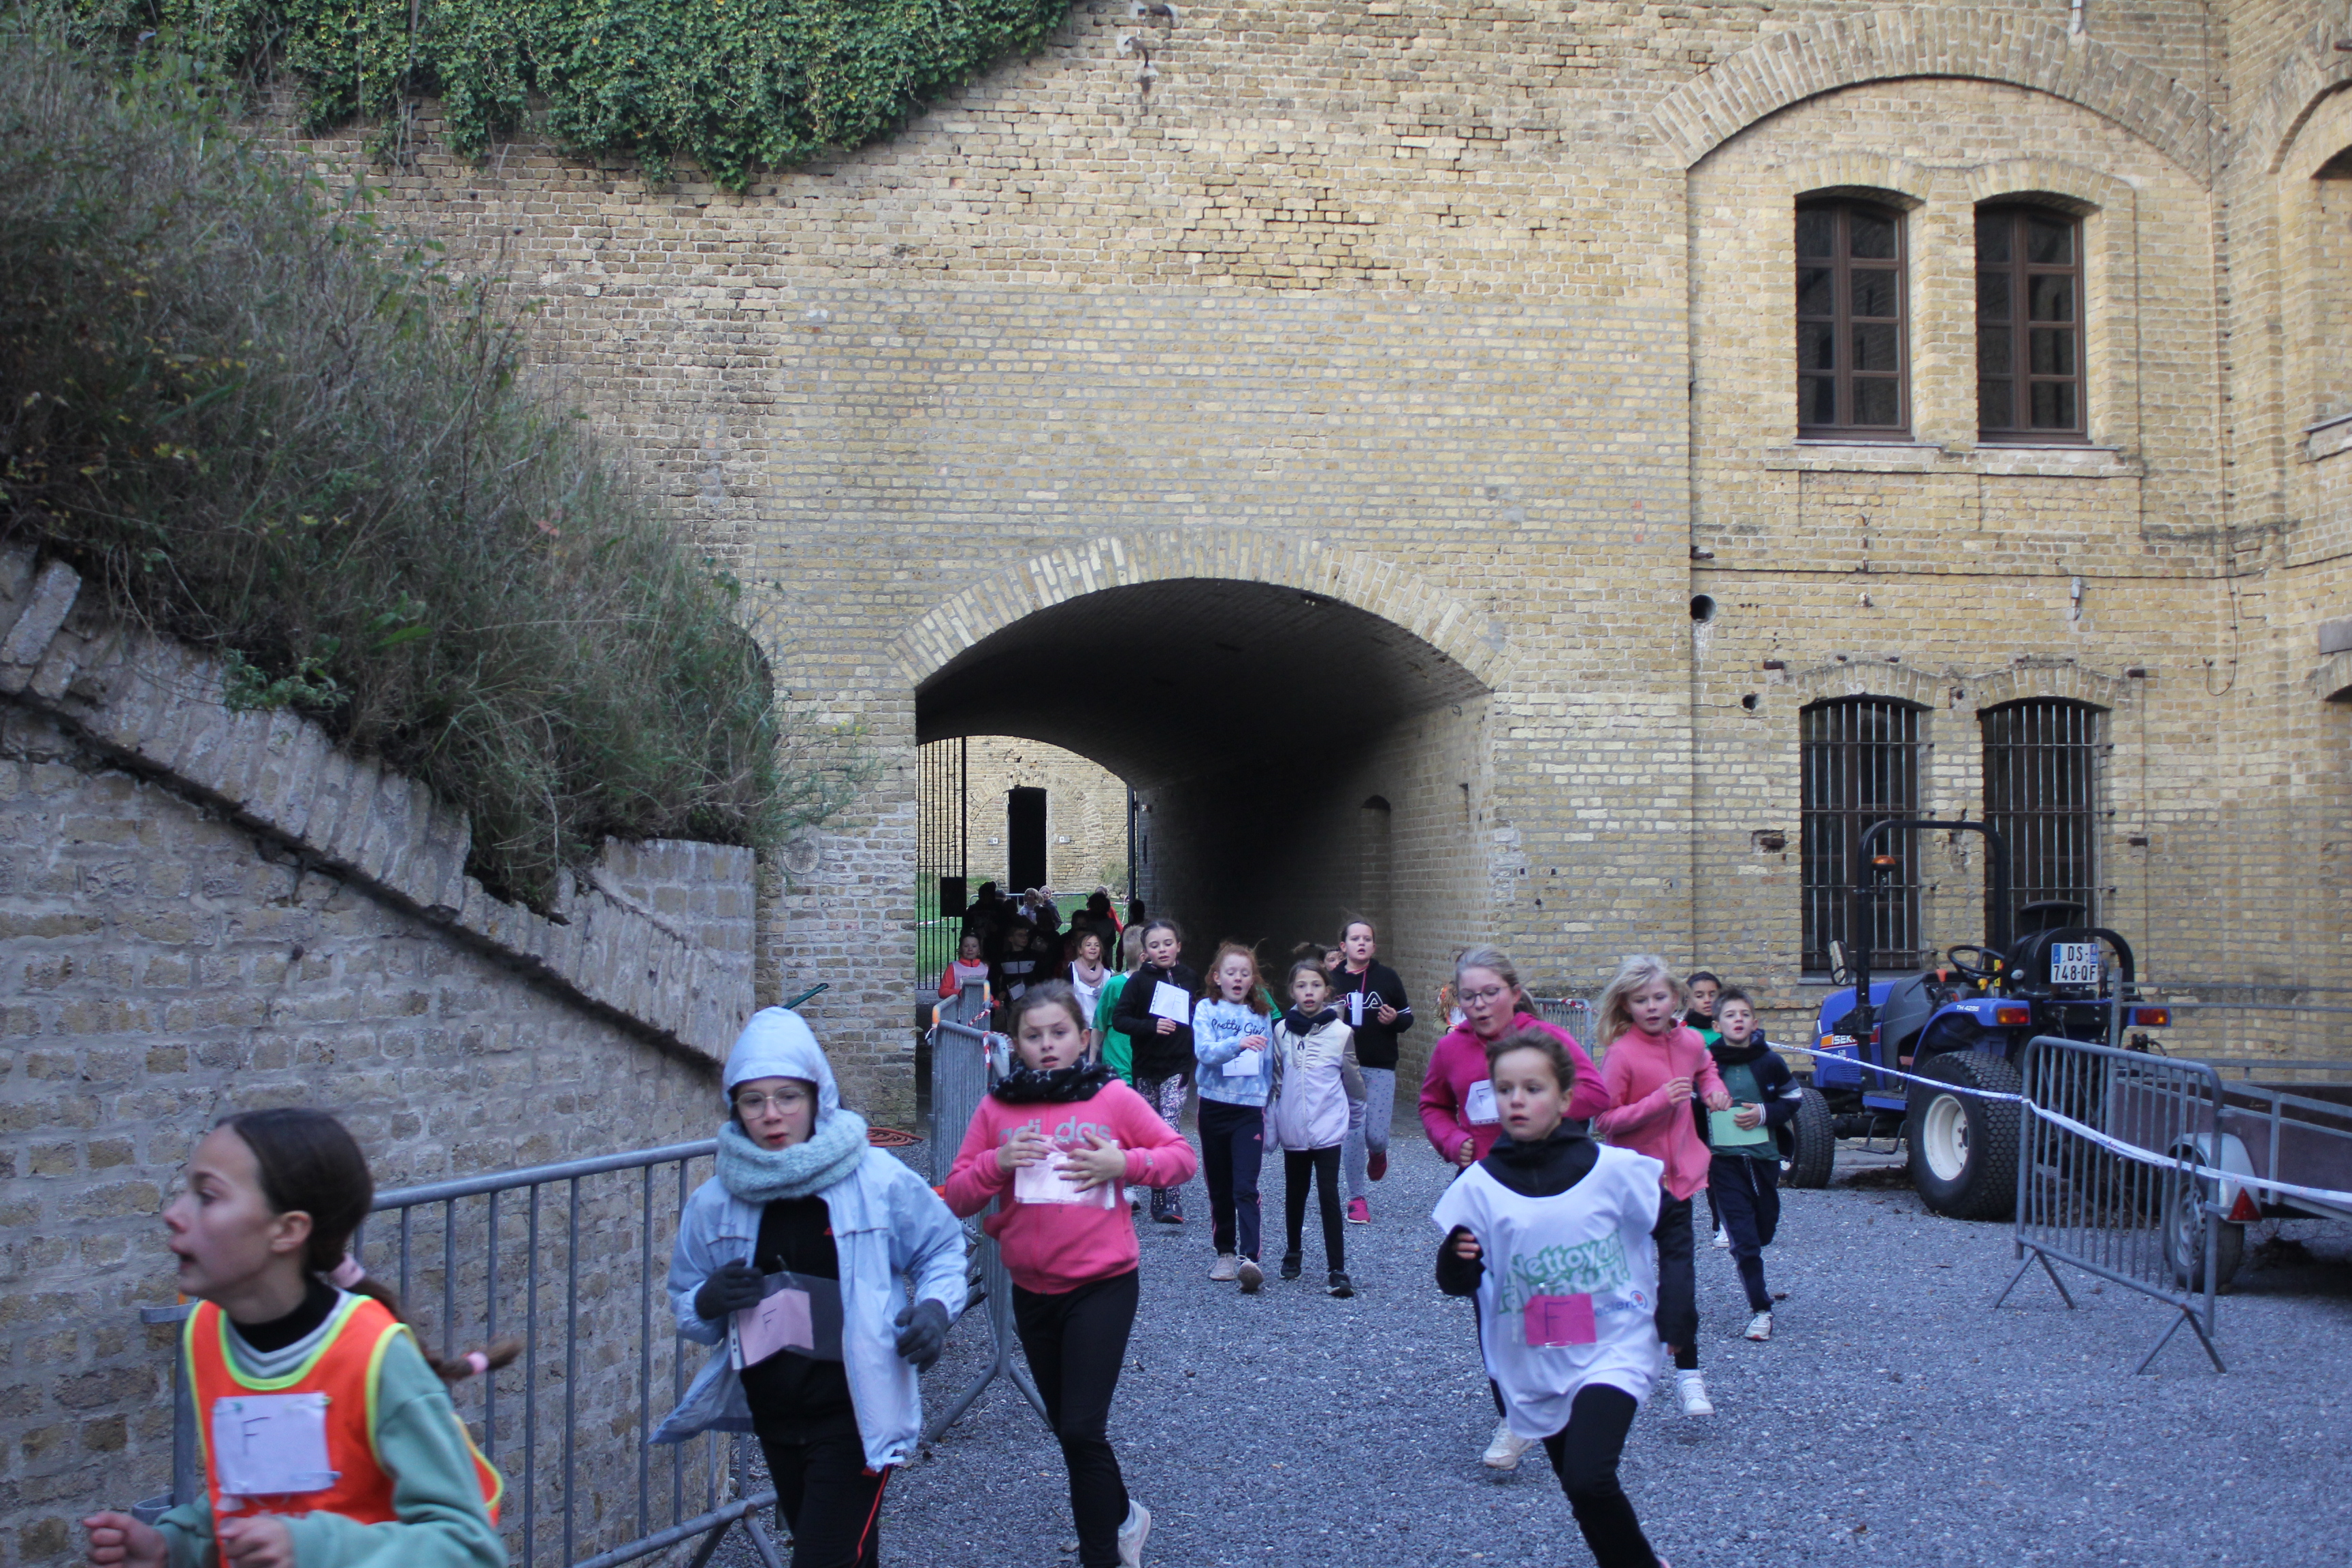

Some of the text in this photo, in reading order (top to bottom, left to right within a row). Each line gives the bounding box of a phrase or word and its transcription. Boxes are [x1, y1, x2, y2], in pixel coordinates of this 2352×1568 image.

[2068, 945, 2088, 961] DS-
[2053, 965, 2096, 981] 748-QF
[1171, 994, 1184, 1010] F
[1211, 1018, 1265, 1036] Pretty Girl
[1831, 1034, 1857, 1045] ISEK
[1234, 1055, 1244, 1069] F
[1475, 1087, 1490, 1106] F
[762, 1307, 777, 1333] F
[1544, 1301, 1572, 1337] F
[242, 1416, 272, 1456] F
